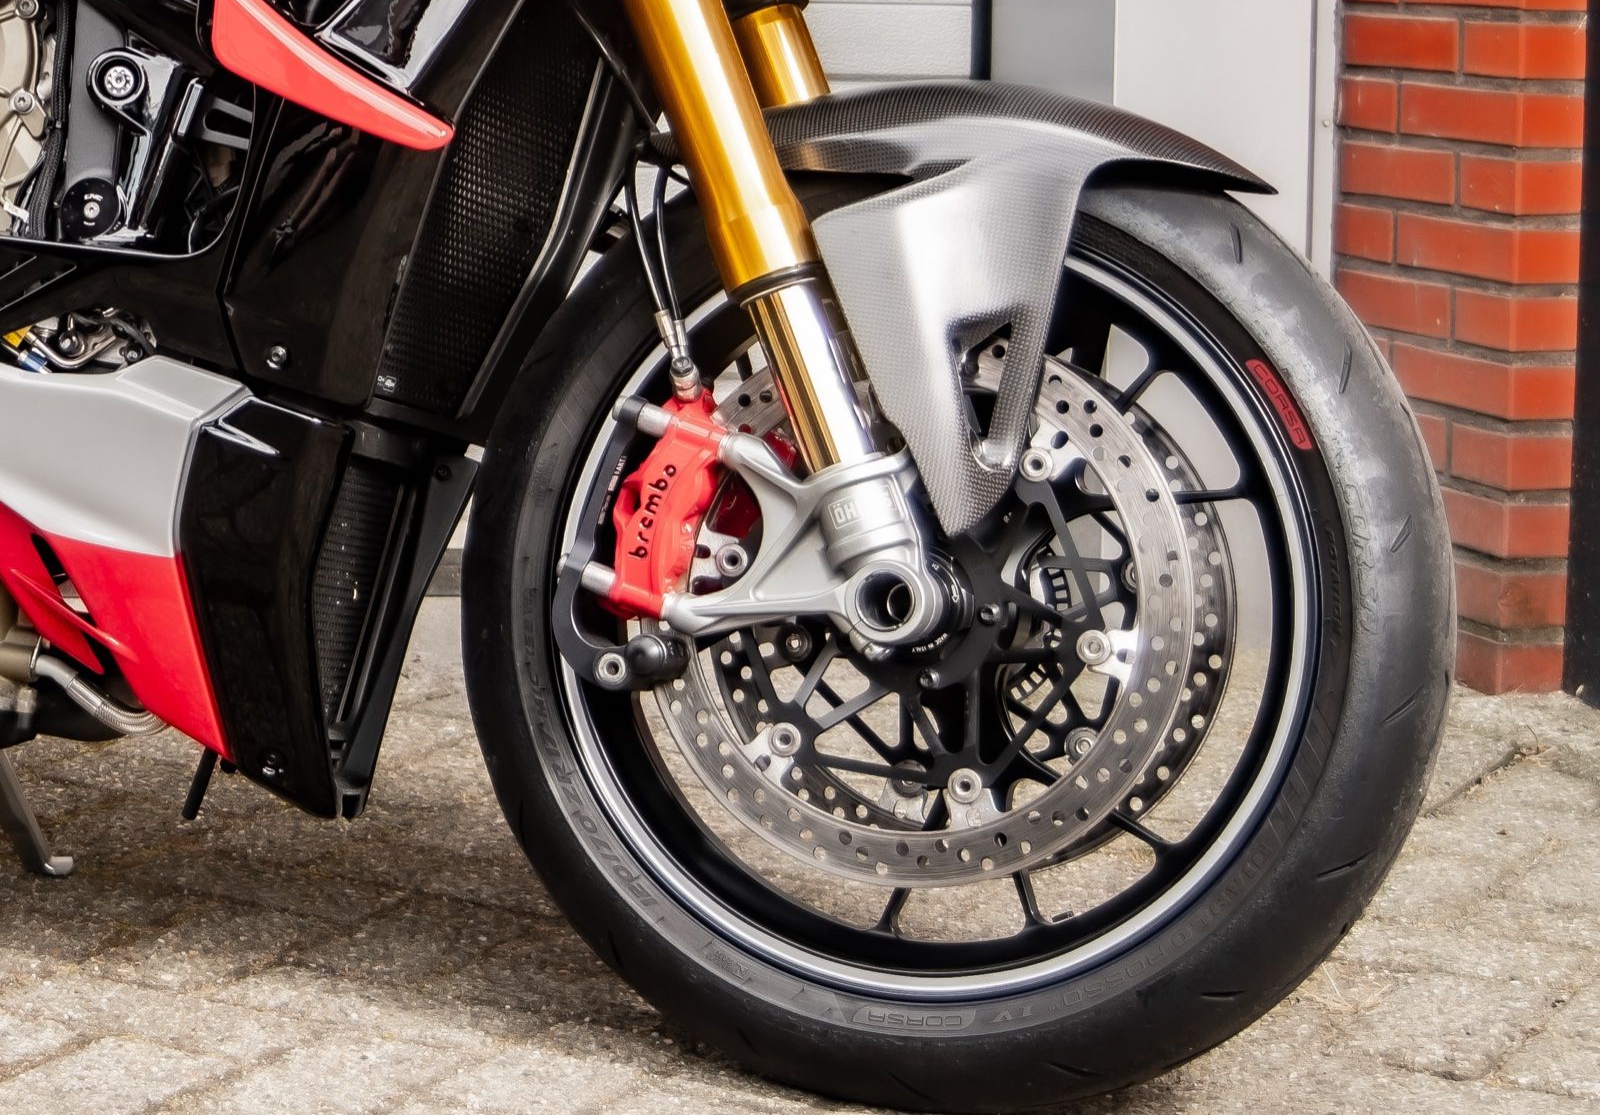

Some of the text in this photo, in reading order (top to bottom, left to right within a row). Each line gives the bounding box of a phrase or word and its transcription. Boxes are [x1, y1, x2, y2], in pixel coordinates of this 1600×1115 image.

[1254, 363, 1306, 444] CORSA
[628, 464, 676, 559] brembo
[867, 1010, 962, 1028] CORSA
